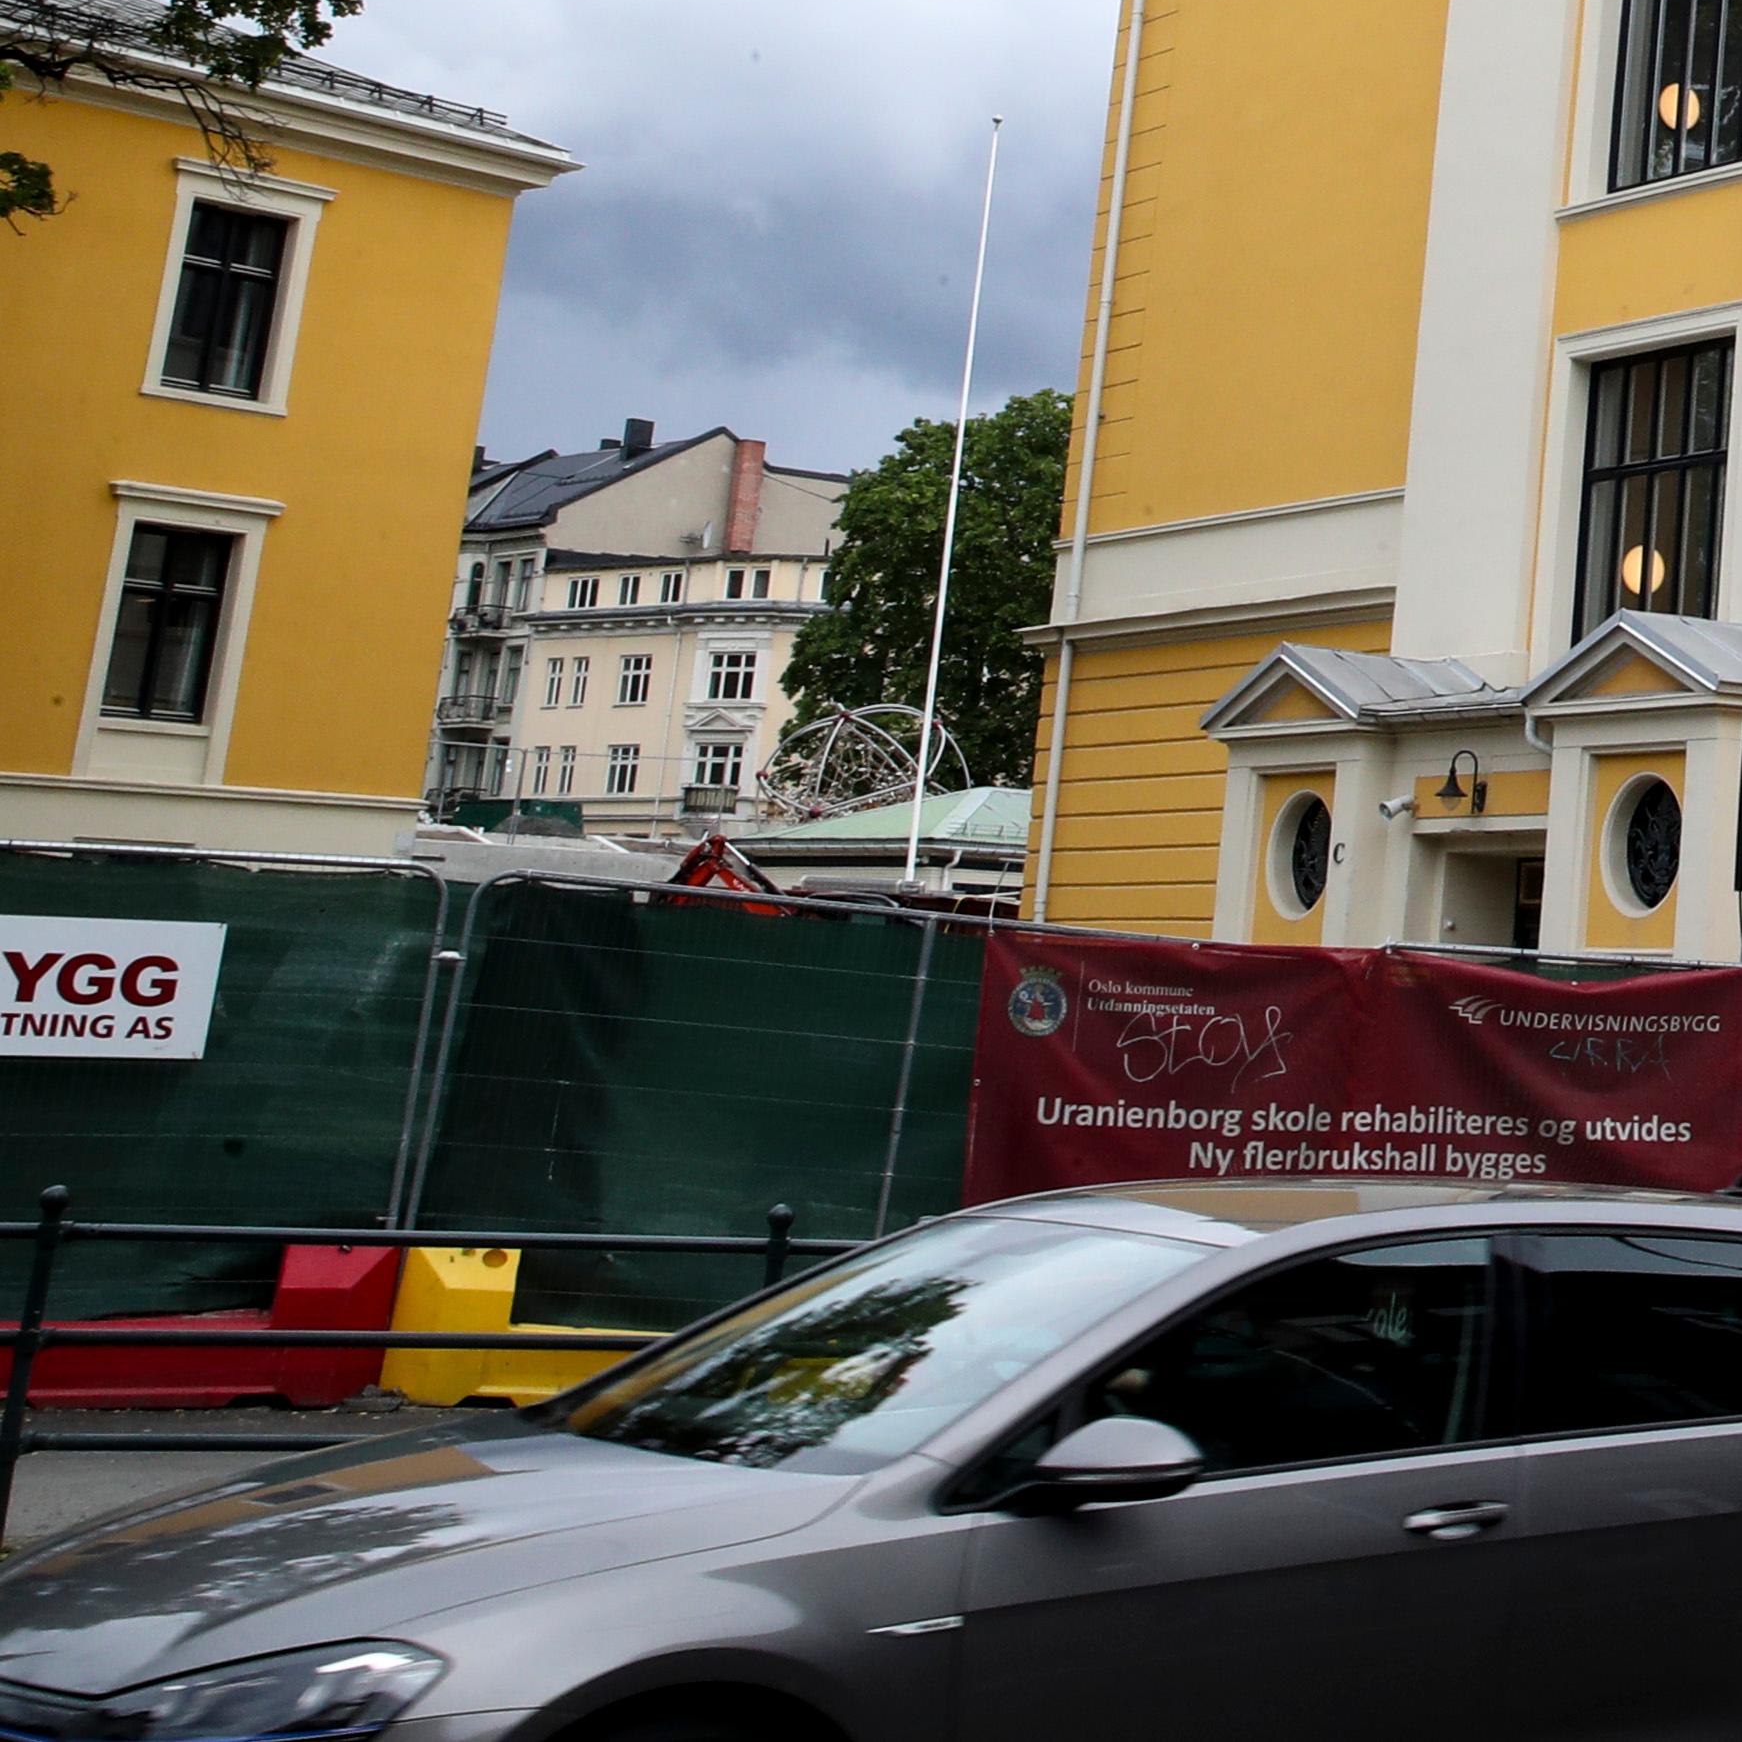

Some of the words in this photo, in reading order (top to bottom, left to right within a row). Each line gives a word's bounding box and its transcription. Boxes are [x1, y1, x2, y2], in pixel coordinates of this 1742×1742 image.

[1333, 842, 1345, 864] C
[2, 951, 179, 1007] YGG
[1088, 978, 1121, 994] Oslo
[1125, 982, 1194, 997] kommune
[1087, 996, 1216, 1017] Utdanningsetaten
[0, 1012, 115, 1039] TNING
[125, 1016, 174, 1040] AS
[1499, 1009, 1721, 1032] UNDERVISNINGSBYGG
[1036, 1096, 1242, 1137] Uranienborg
[1251, 1102, 1331, 1132] skole
[1340, 1103, 1529, 1136] rehabiliteres
[1538, 1118, 1576, 1145] og
[1585, 1115, 1692, 1142] utvides
[1189, 1141, 1234, 1176] Ny
[1243, 1141, 1436, 1171] flerbrukshall
[1445, 1144, 1547, 1180] bygges
